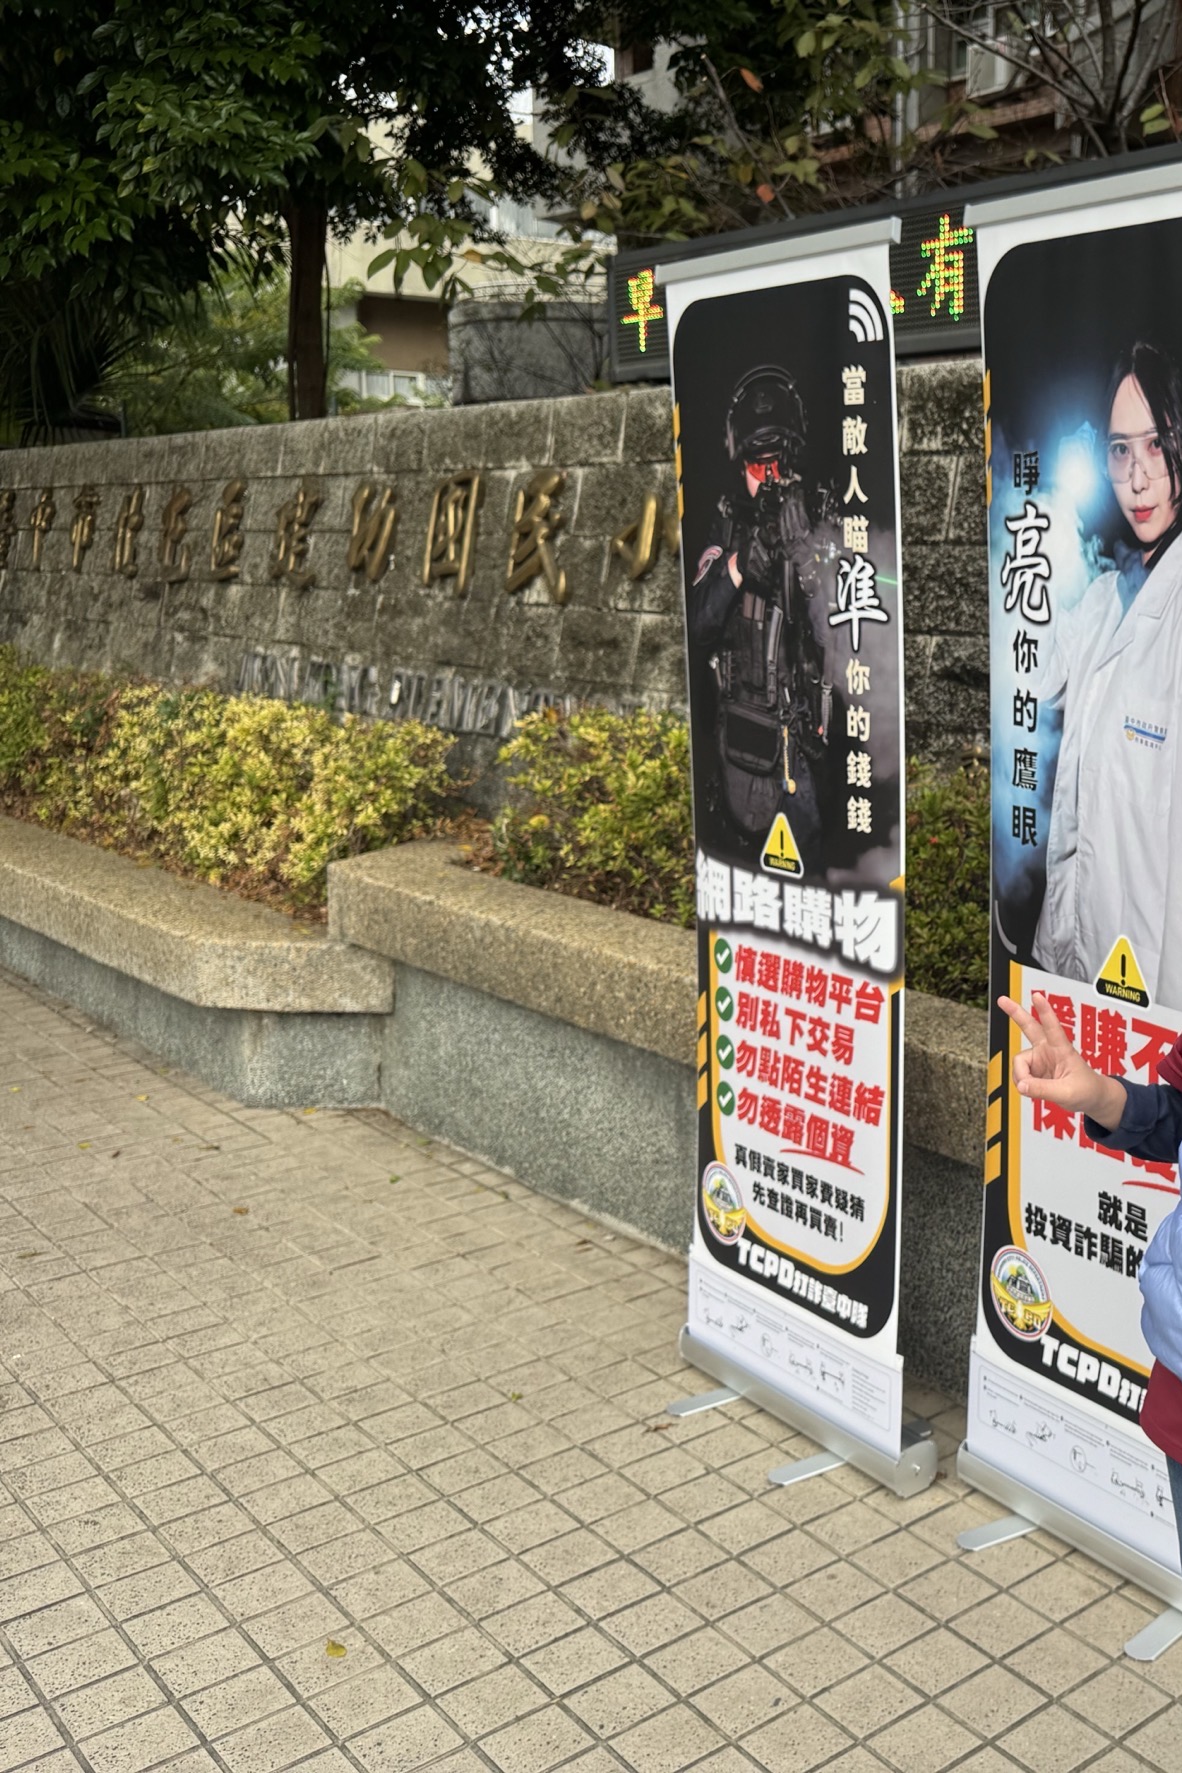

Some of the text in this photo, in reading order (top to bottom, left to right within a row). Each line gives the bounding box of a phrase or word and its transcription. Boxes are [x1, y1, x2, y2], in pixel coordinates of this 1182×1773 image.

[1001, 451, 1051, 848] 睜亮你的鷹眼
[768, 855, 797, 872] WARNING
[696, 847, 898, 975] 網路購物
[735, 944, 885, 1024] 慎選購物平台
[1104, 982, 1141, 1003] WARNING
[735, 991, 854, 1066] 別私下交易
[735, 1040, 885, 1127] 勿點陌生連結
[737, 1087, 855, 1164] 勿透露個資
[1025, 1202, 1144, 1279] 投資詐騙的
[1098, 1190, 1148, 1243] 就是
